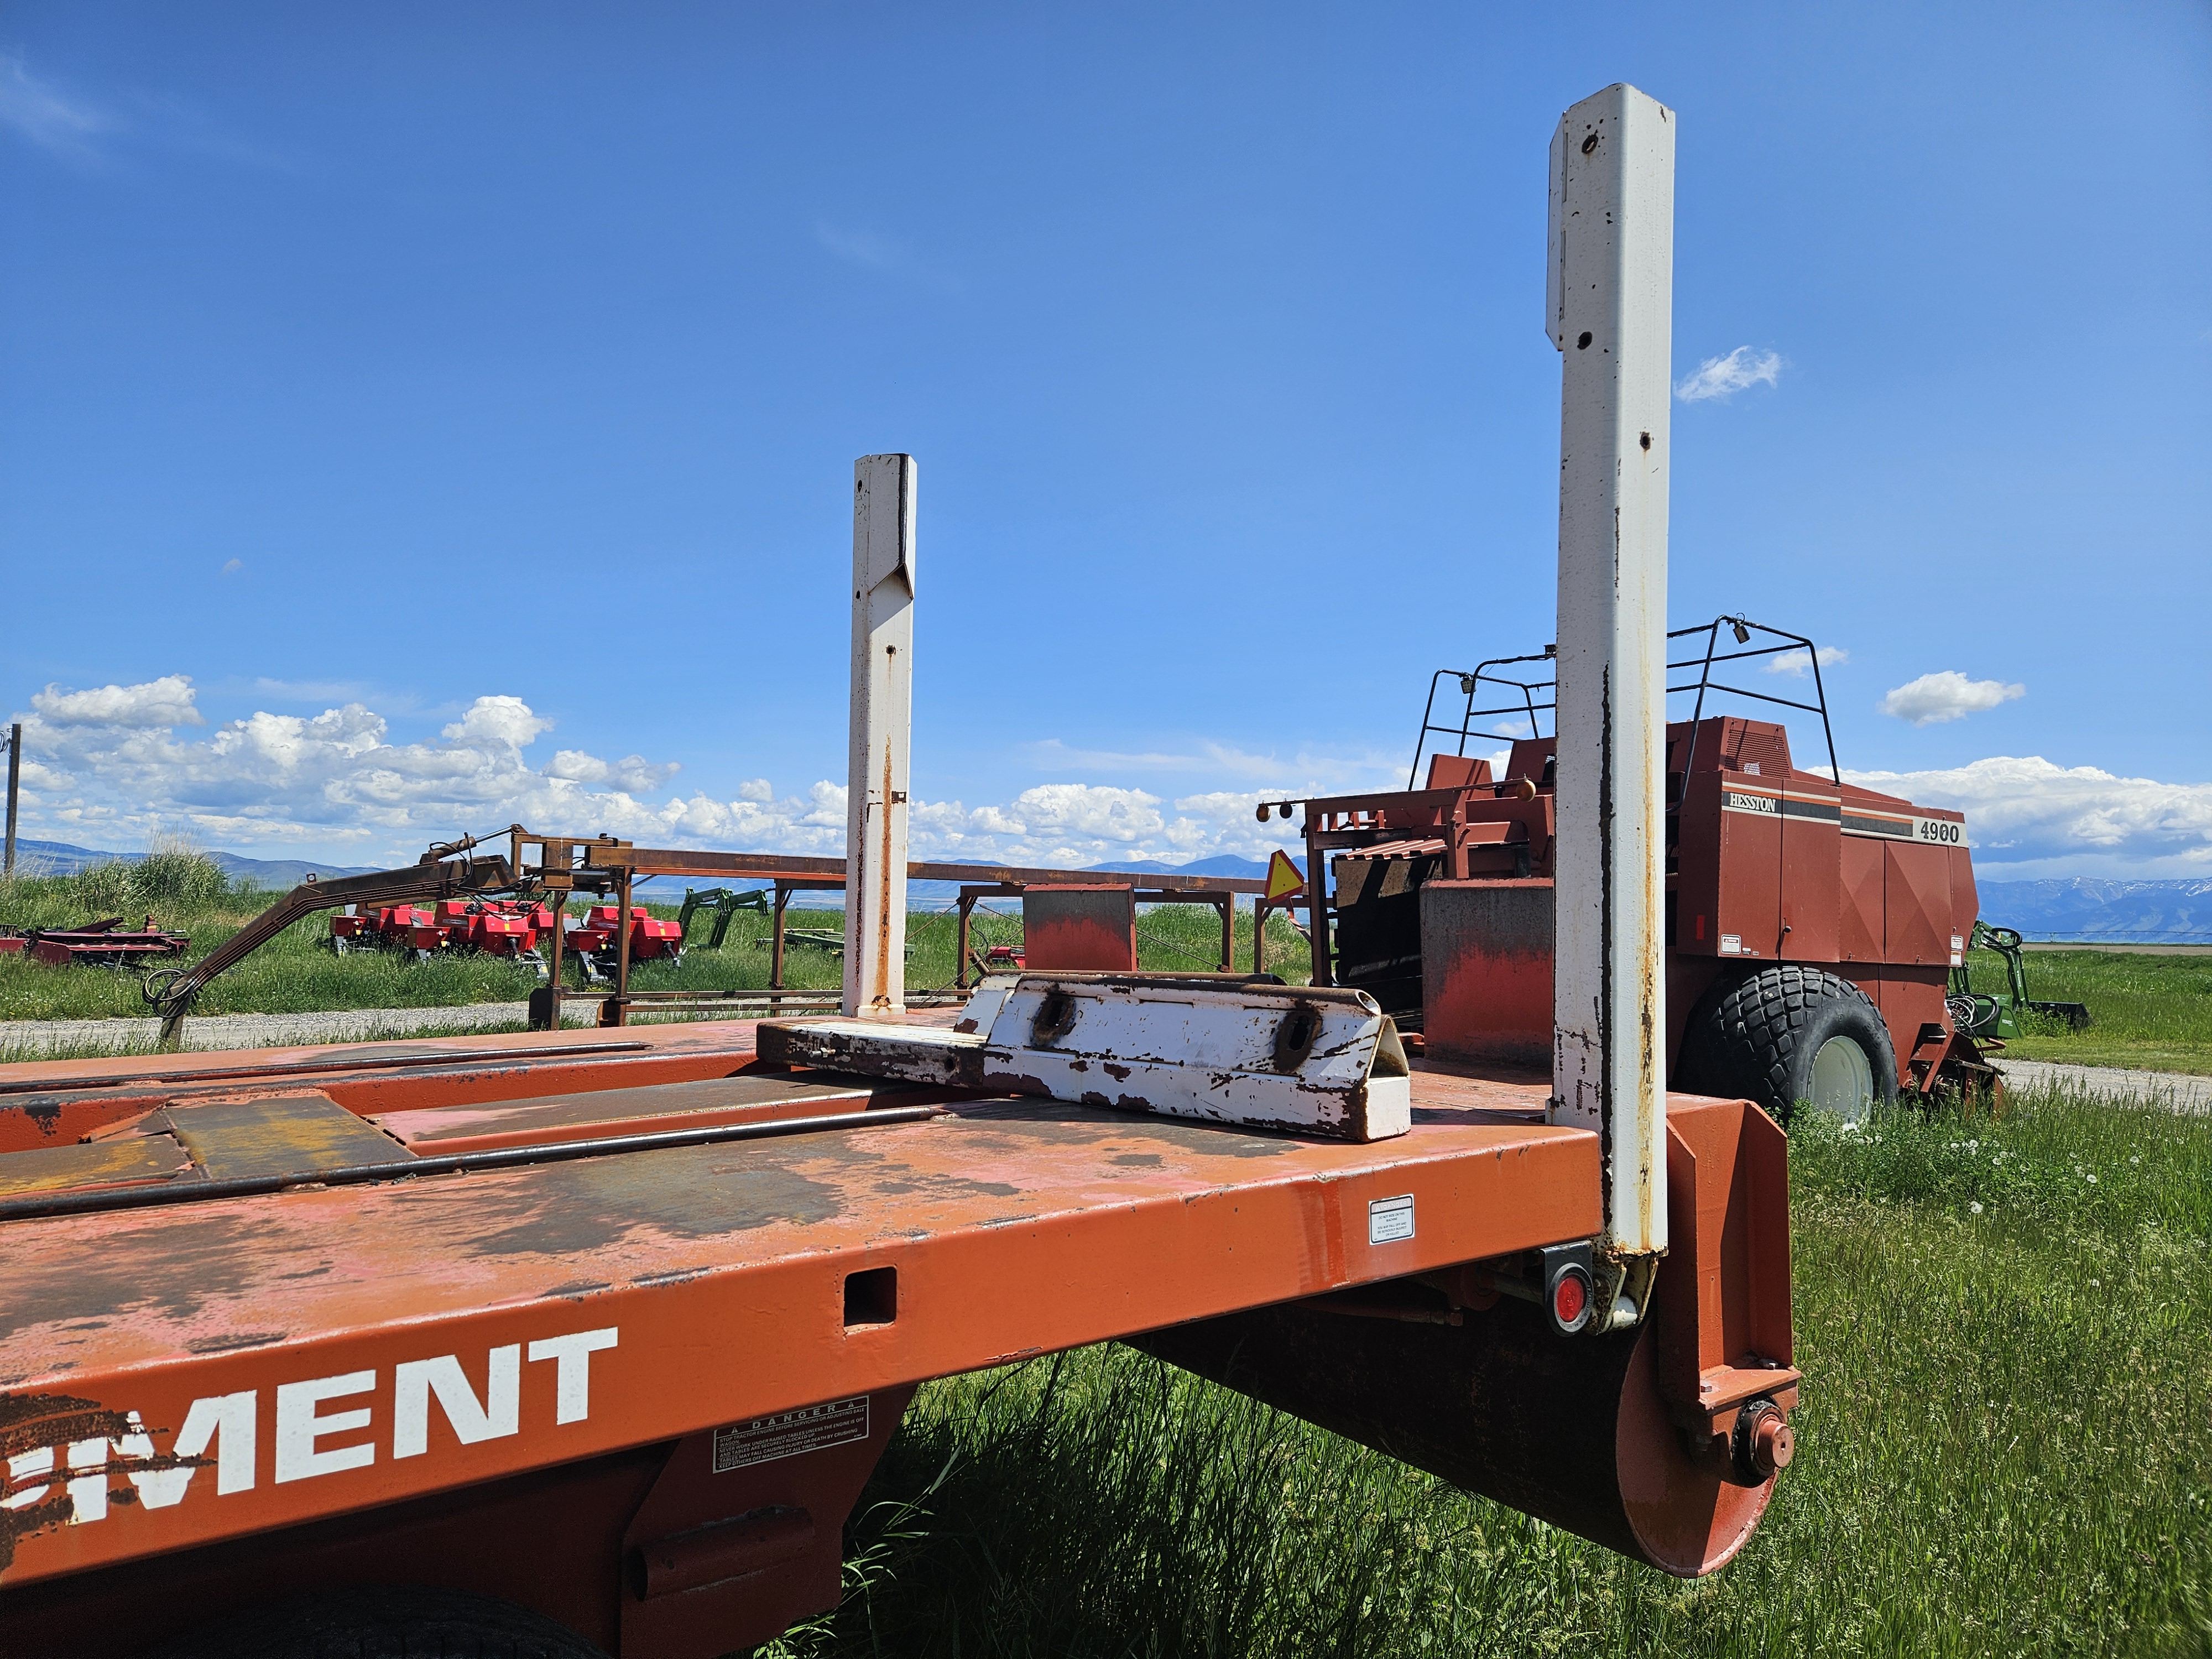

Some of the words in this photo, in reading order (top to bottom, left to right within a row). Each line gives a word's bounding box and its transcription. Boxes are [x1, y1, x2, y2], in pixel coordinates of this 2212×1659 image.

[1729, 792, 1776, 812] HESSTON
[1921, 821, 1959, 843] 4900
[1383, 1201, 1407, 1209] DANGER
[733, 1431, 757, 1440] TRACTOR
[757, 1426, 774, 1435] ENGINE
[775, 1423, 794, 1431] BEFORE
[794, 1418, 819, 1427] SERVICING
[826, 1410, 853, 1420] ADJUSTING
[752, 1405, 836, 1430] DANGER
[761, 1438, 785, 1448] SECURELY
[785, 1434, 808, 1443] BLOCKED
[763, 1444, 785, 1453] CAUSING
[811, 1435, 827, 1443] DEATH
[834, 1428, 858, 1437] CRUSHING
[762, 1450, 785, 1459] MACHINE
